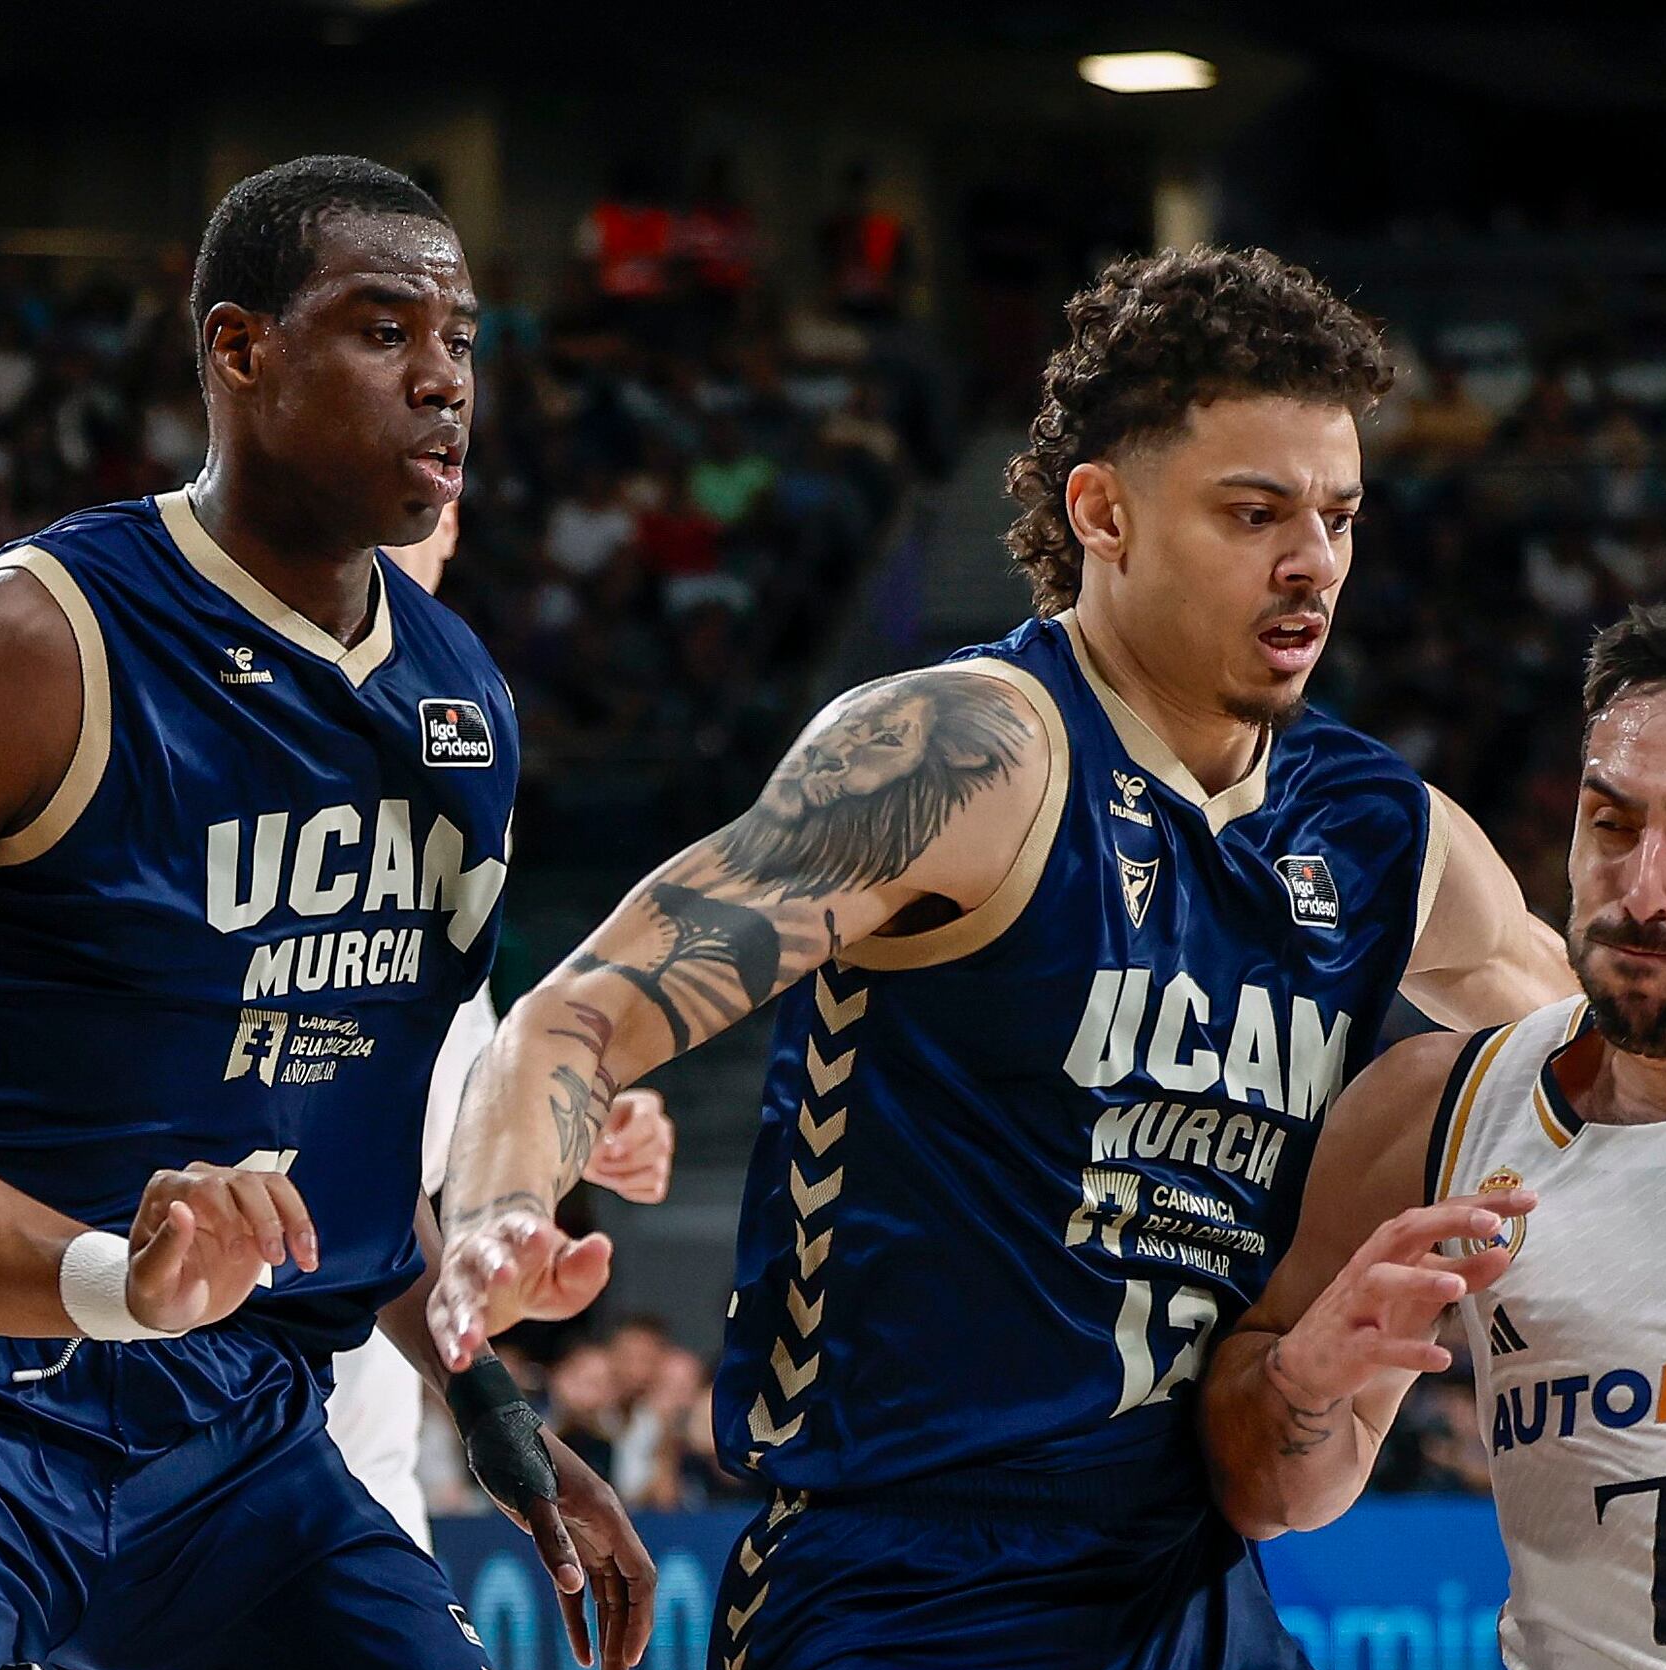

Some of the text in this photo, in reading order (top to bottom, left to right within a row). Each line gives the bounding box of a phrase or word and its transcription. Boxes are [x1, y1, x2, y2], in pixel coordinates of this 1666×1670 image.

[220, 670, 273, 684] hummel
[430, 719, 457, 741] liga
[431, 736, 488, 757] endesa
[1109, 800, 1153, 827] hummel
[206, 799, 507, 954] UCAM
[1290, 875, 1315, 897] liga
[1297, 897, 1336, 918] endesa
[242, 929, 424, 1001] MURCIA
[1062, 968, 1352, 1121] UCAM
[1091, 1100, 1287, 1191] MURCIA
[1152, 1185, 1235, 1226] CARAVACA
[1136, 1233, 1175, 1260] AÑO
[1143, 1214, 1172, 1231] DE
[1167, 1220, 1193, 1236] LA
[1233, 1230, 1266, 1257] 2024
